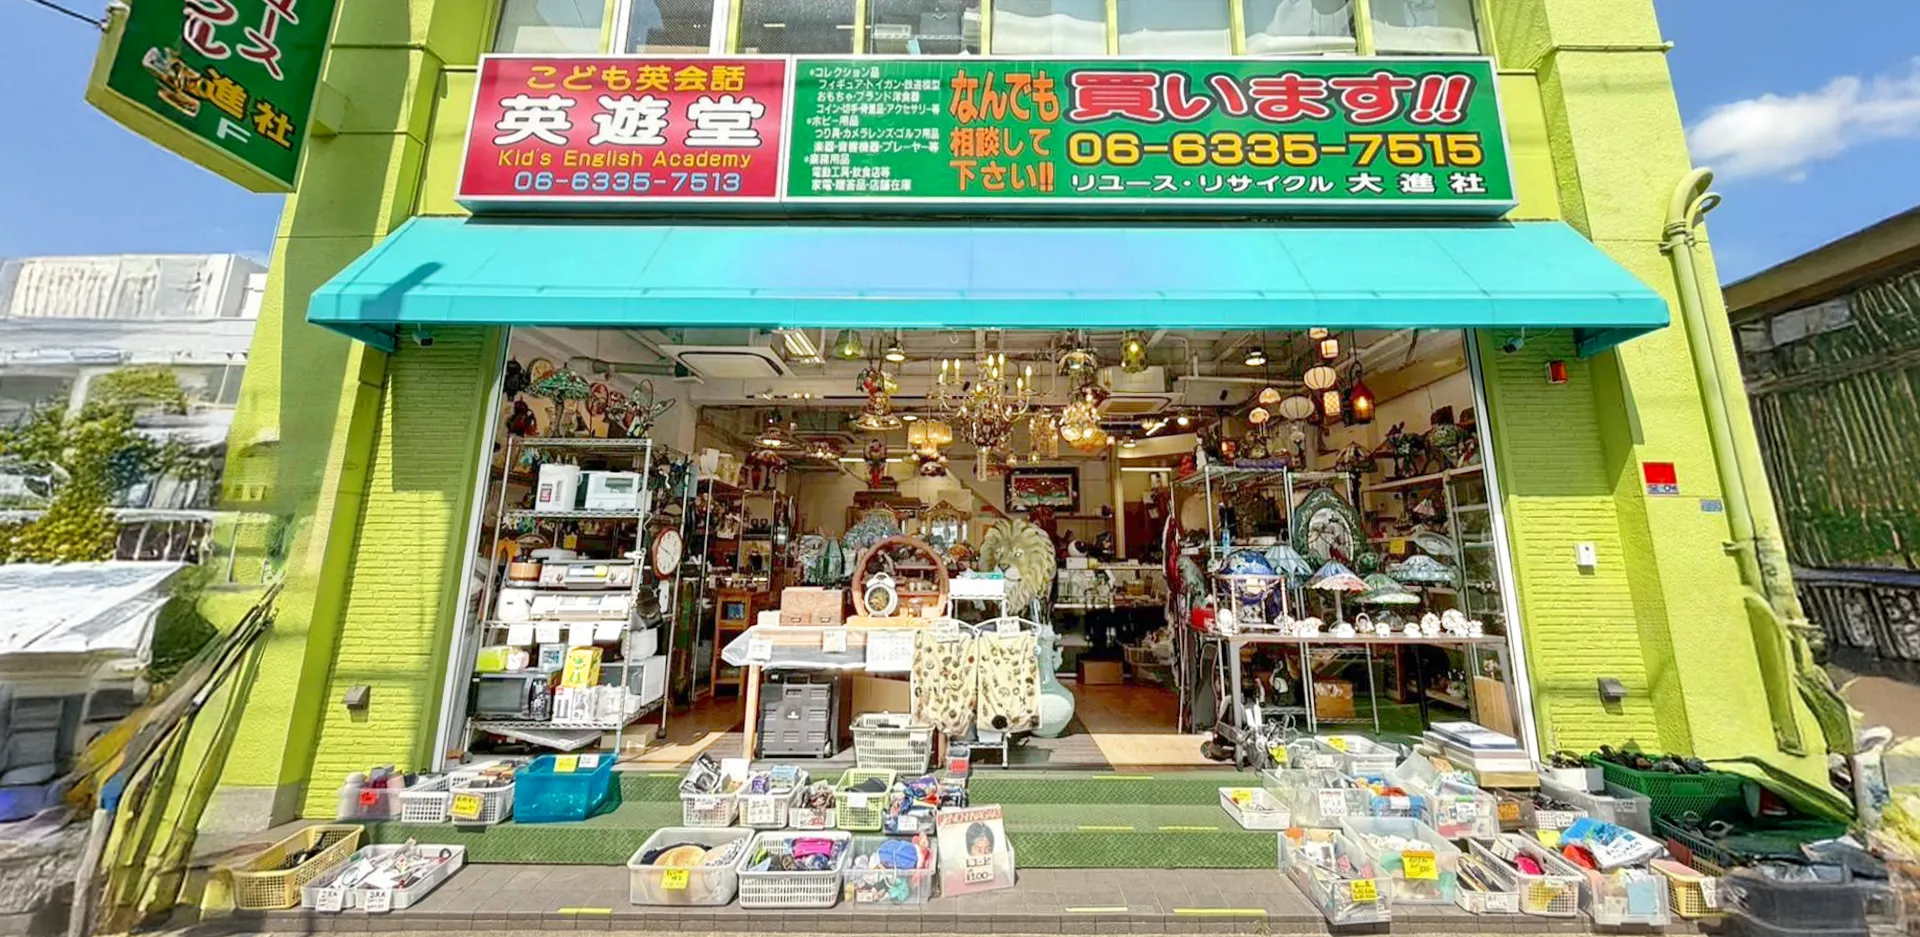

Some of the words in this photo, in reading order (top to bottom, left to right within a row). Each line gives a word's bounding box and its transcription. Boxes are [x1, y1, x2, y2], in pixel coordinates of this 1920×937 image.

[526, 65, 746, 92] こども英会話
[814, 67, 880, 78] コレクション品
[949, 68, 1060, 123] なんでも
[811, 116, 858, 127] ホビー用品
[950, 127, 1051, 157] 相談して
[1069, 134, 1481, 165] 06-6335-7515
[498, 149, 552, 166] Kid's
[563, 150, 643, 168] English
[652, 150, 752, 168] Academy
[514, 172, 741, 192] 06-6335-7513
[1071, 175, 1333, 193] リユース・リサイクル
[1347, 174, 1487, 194] 大進社
